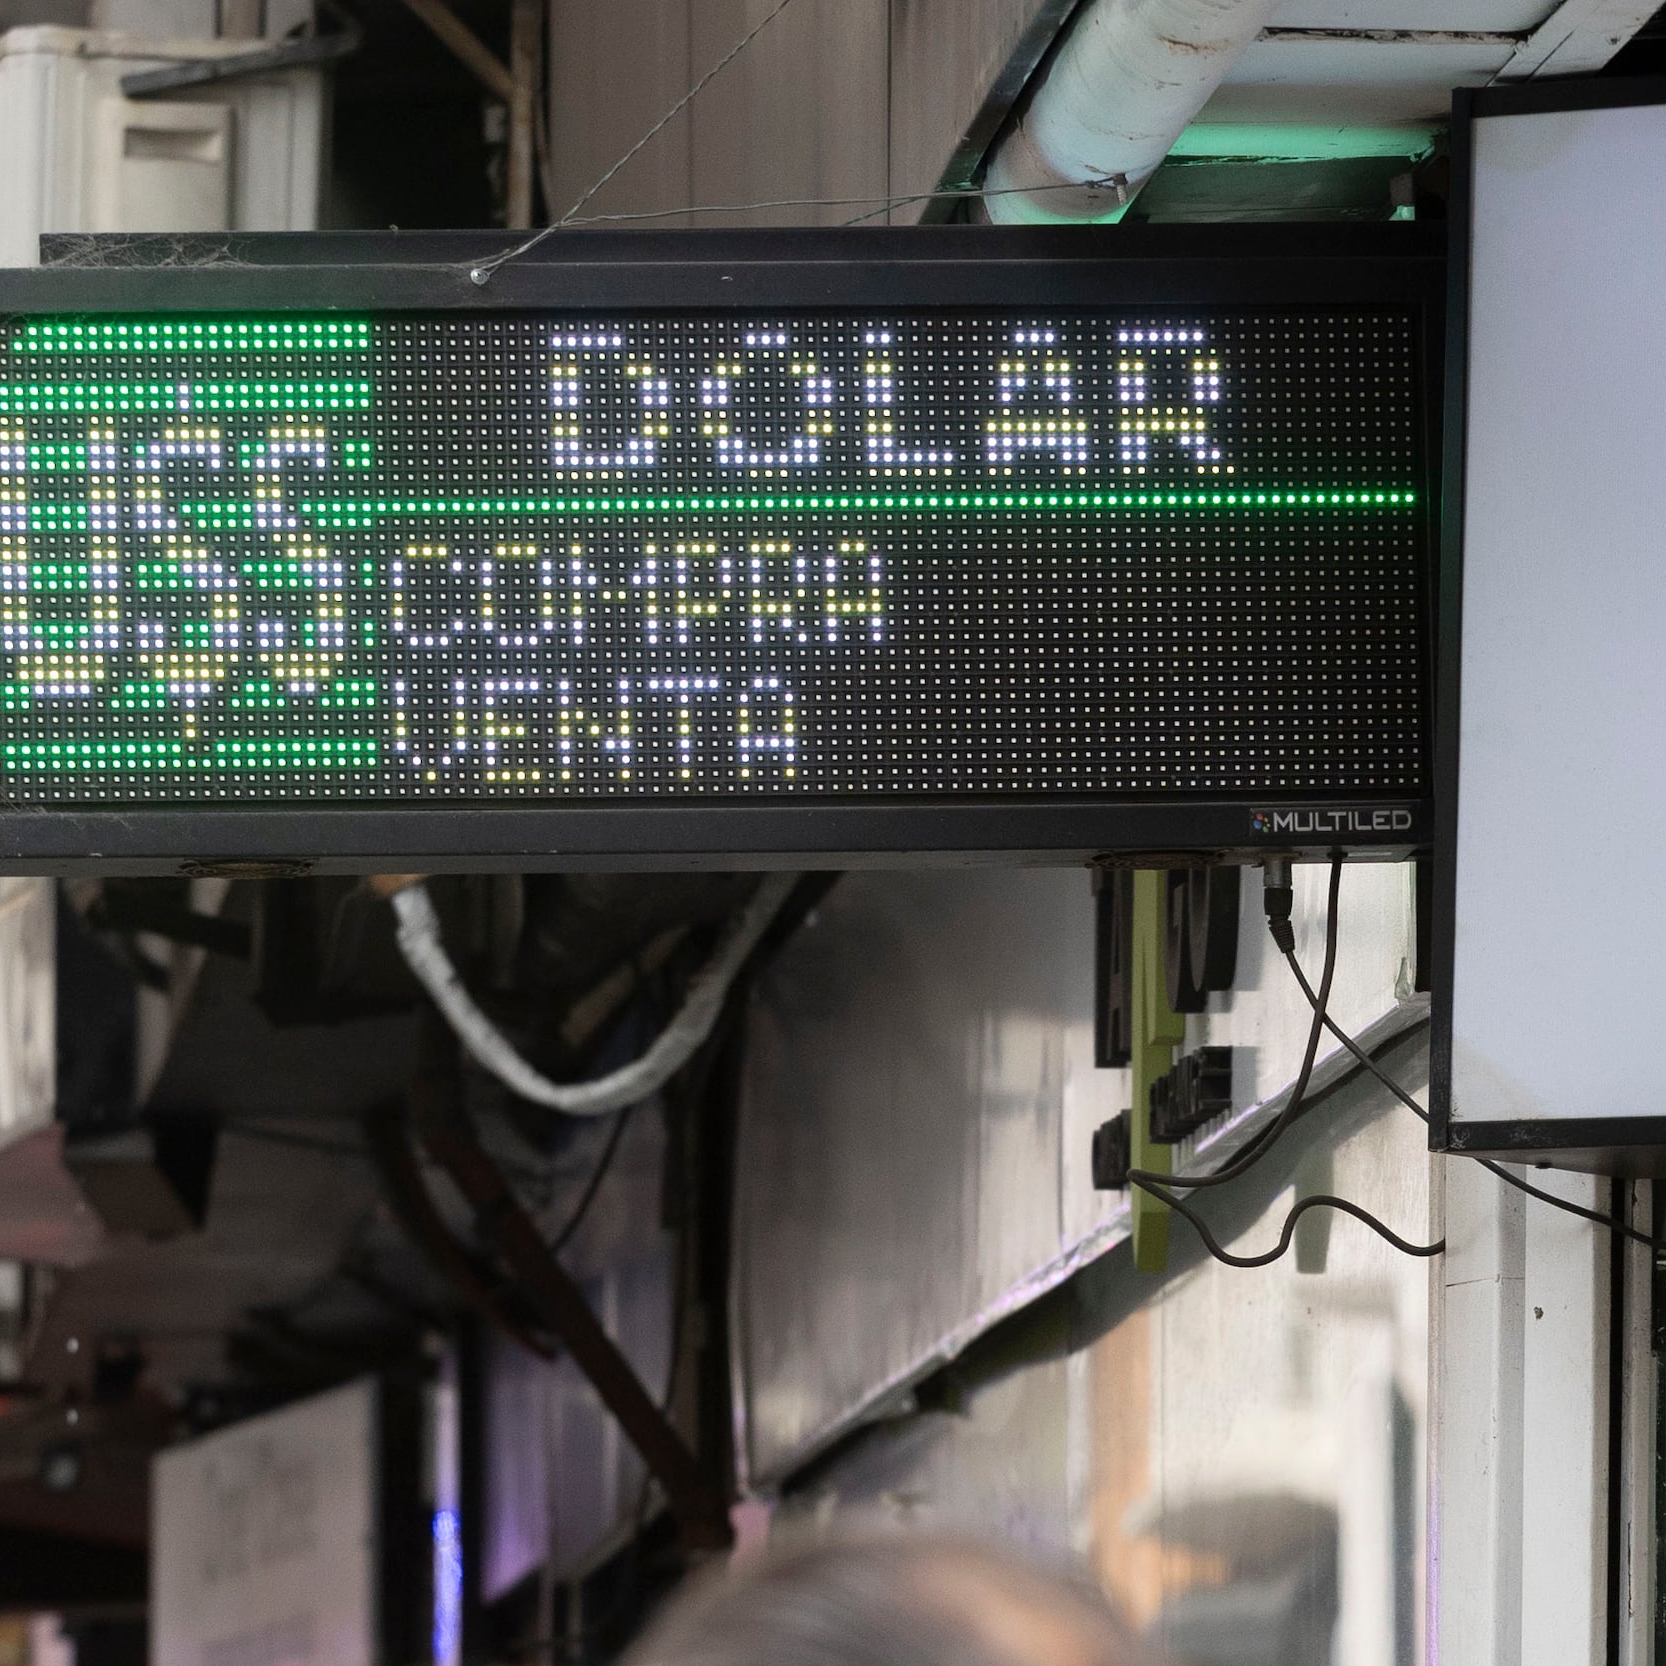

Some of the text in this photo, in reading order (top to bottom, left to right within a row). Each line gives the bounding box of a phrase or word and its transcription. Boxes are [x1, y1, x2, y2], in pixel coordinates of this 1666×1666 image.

[552, 335, 1236, 476] DOLAR
[392, 544, 884, 646] COMPRA
[394, 678, 797, 781] VENTA
[1273, 810, 1412, 832] MULTILED
